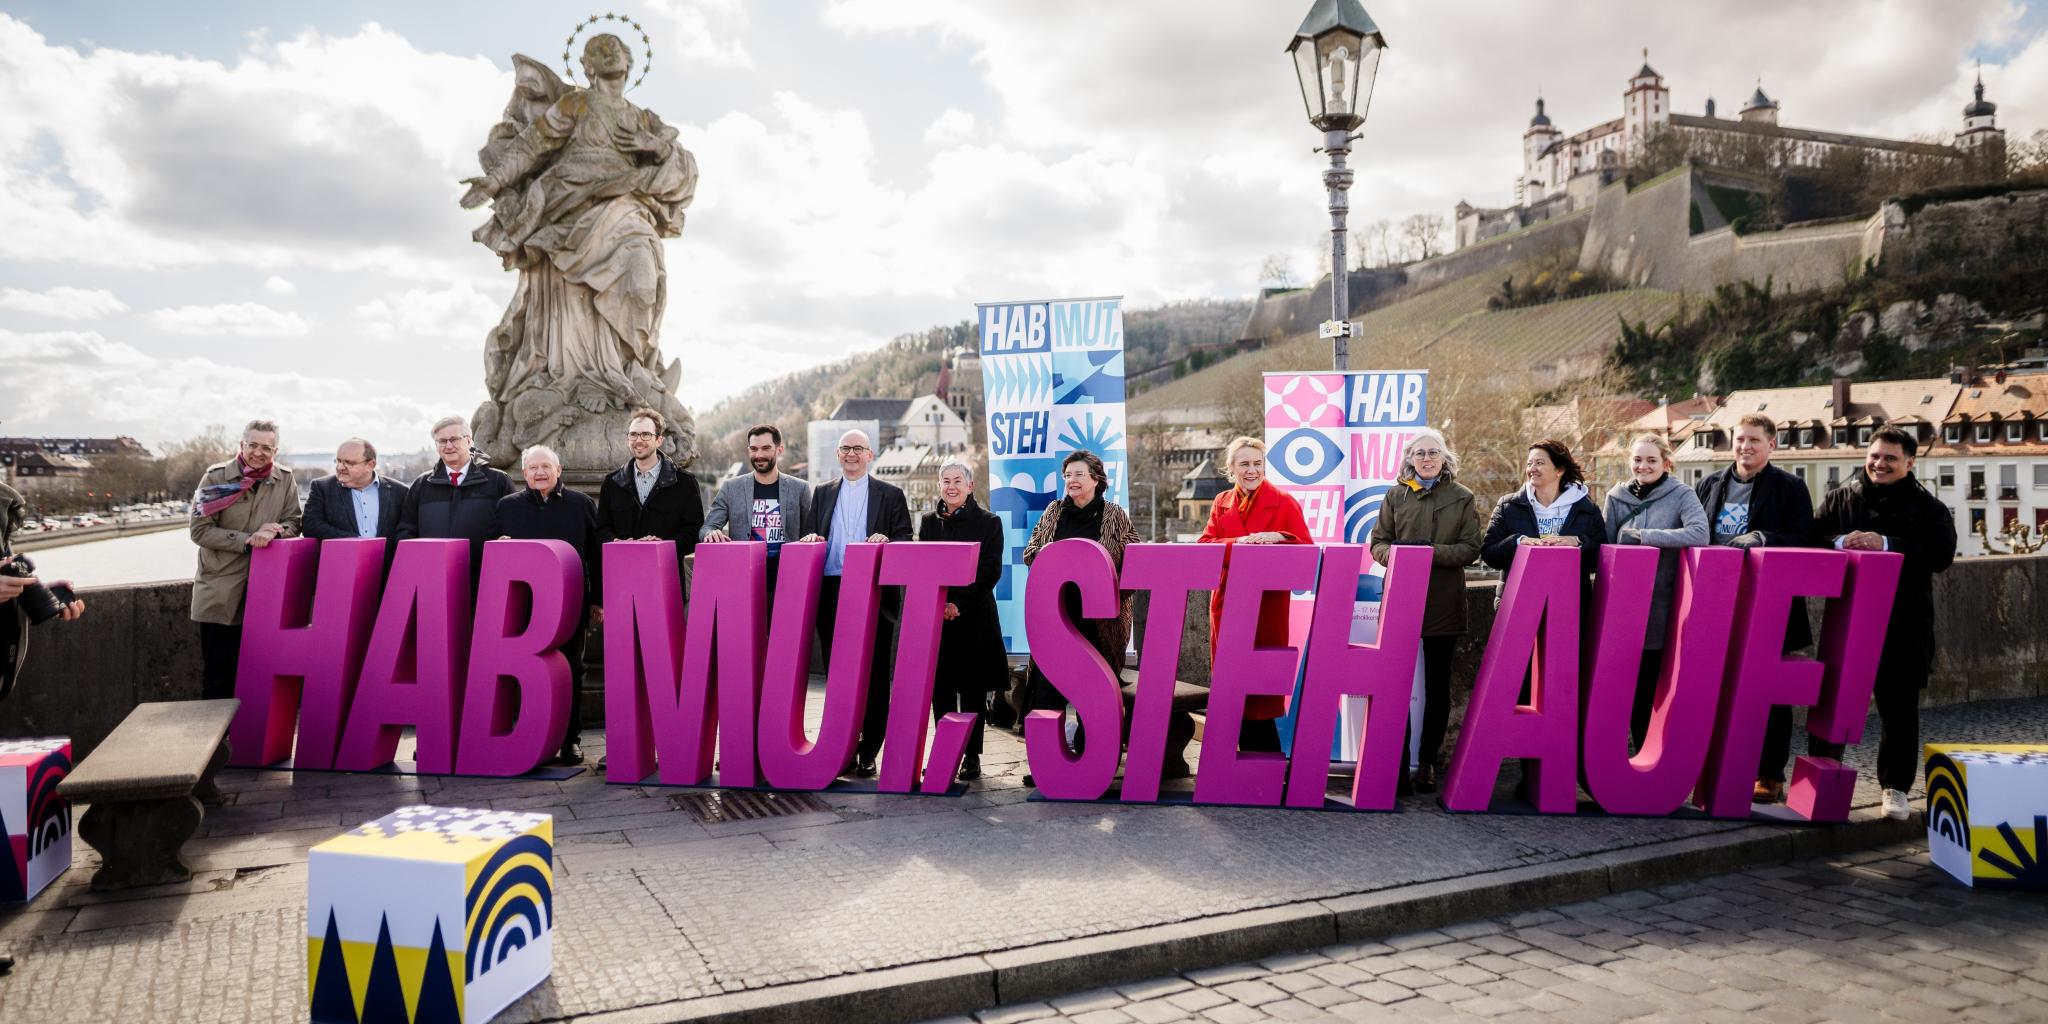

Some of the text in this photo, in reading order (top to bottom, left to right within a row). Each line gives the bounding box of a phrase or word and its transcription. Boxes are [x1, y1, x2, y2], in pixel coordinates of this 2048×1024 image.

[984, 302, 1119, 351] HAB MUT,
[1349, 374, 1423, 422] HAB
[991, 411, 1050, 455] STEH
[228, 537, 1904, 822] HAB MUT, STEH AUF!
